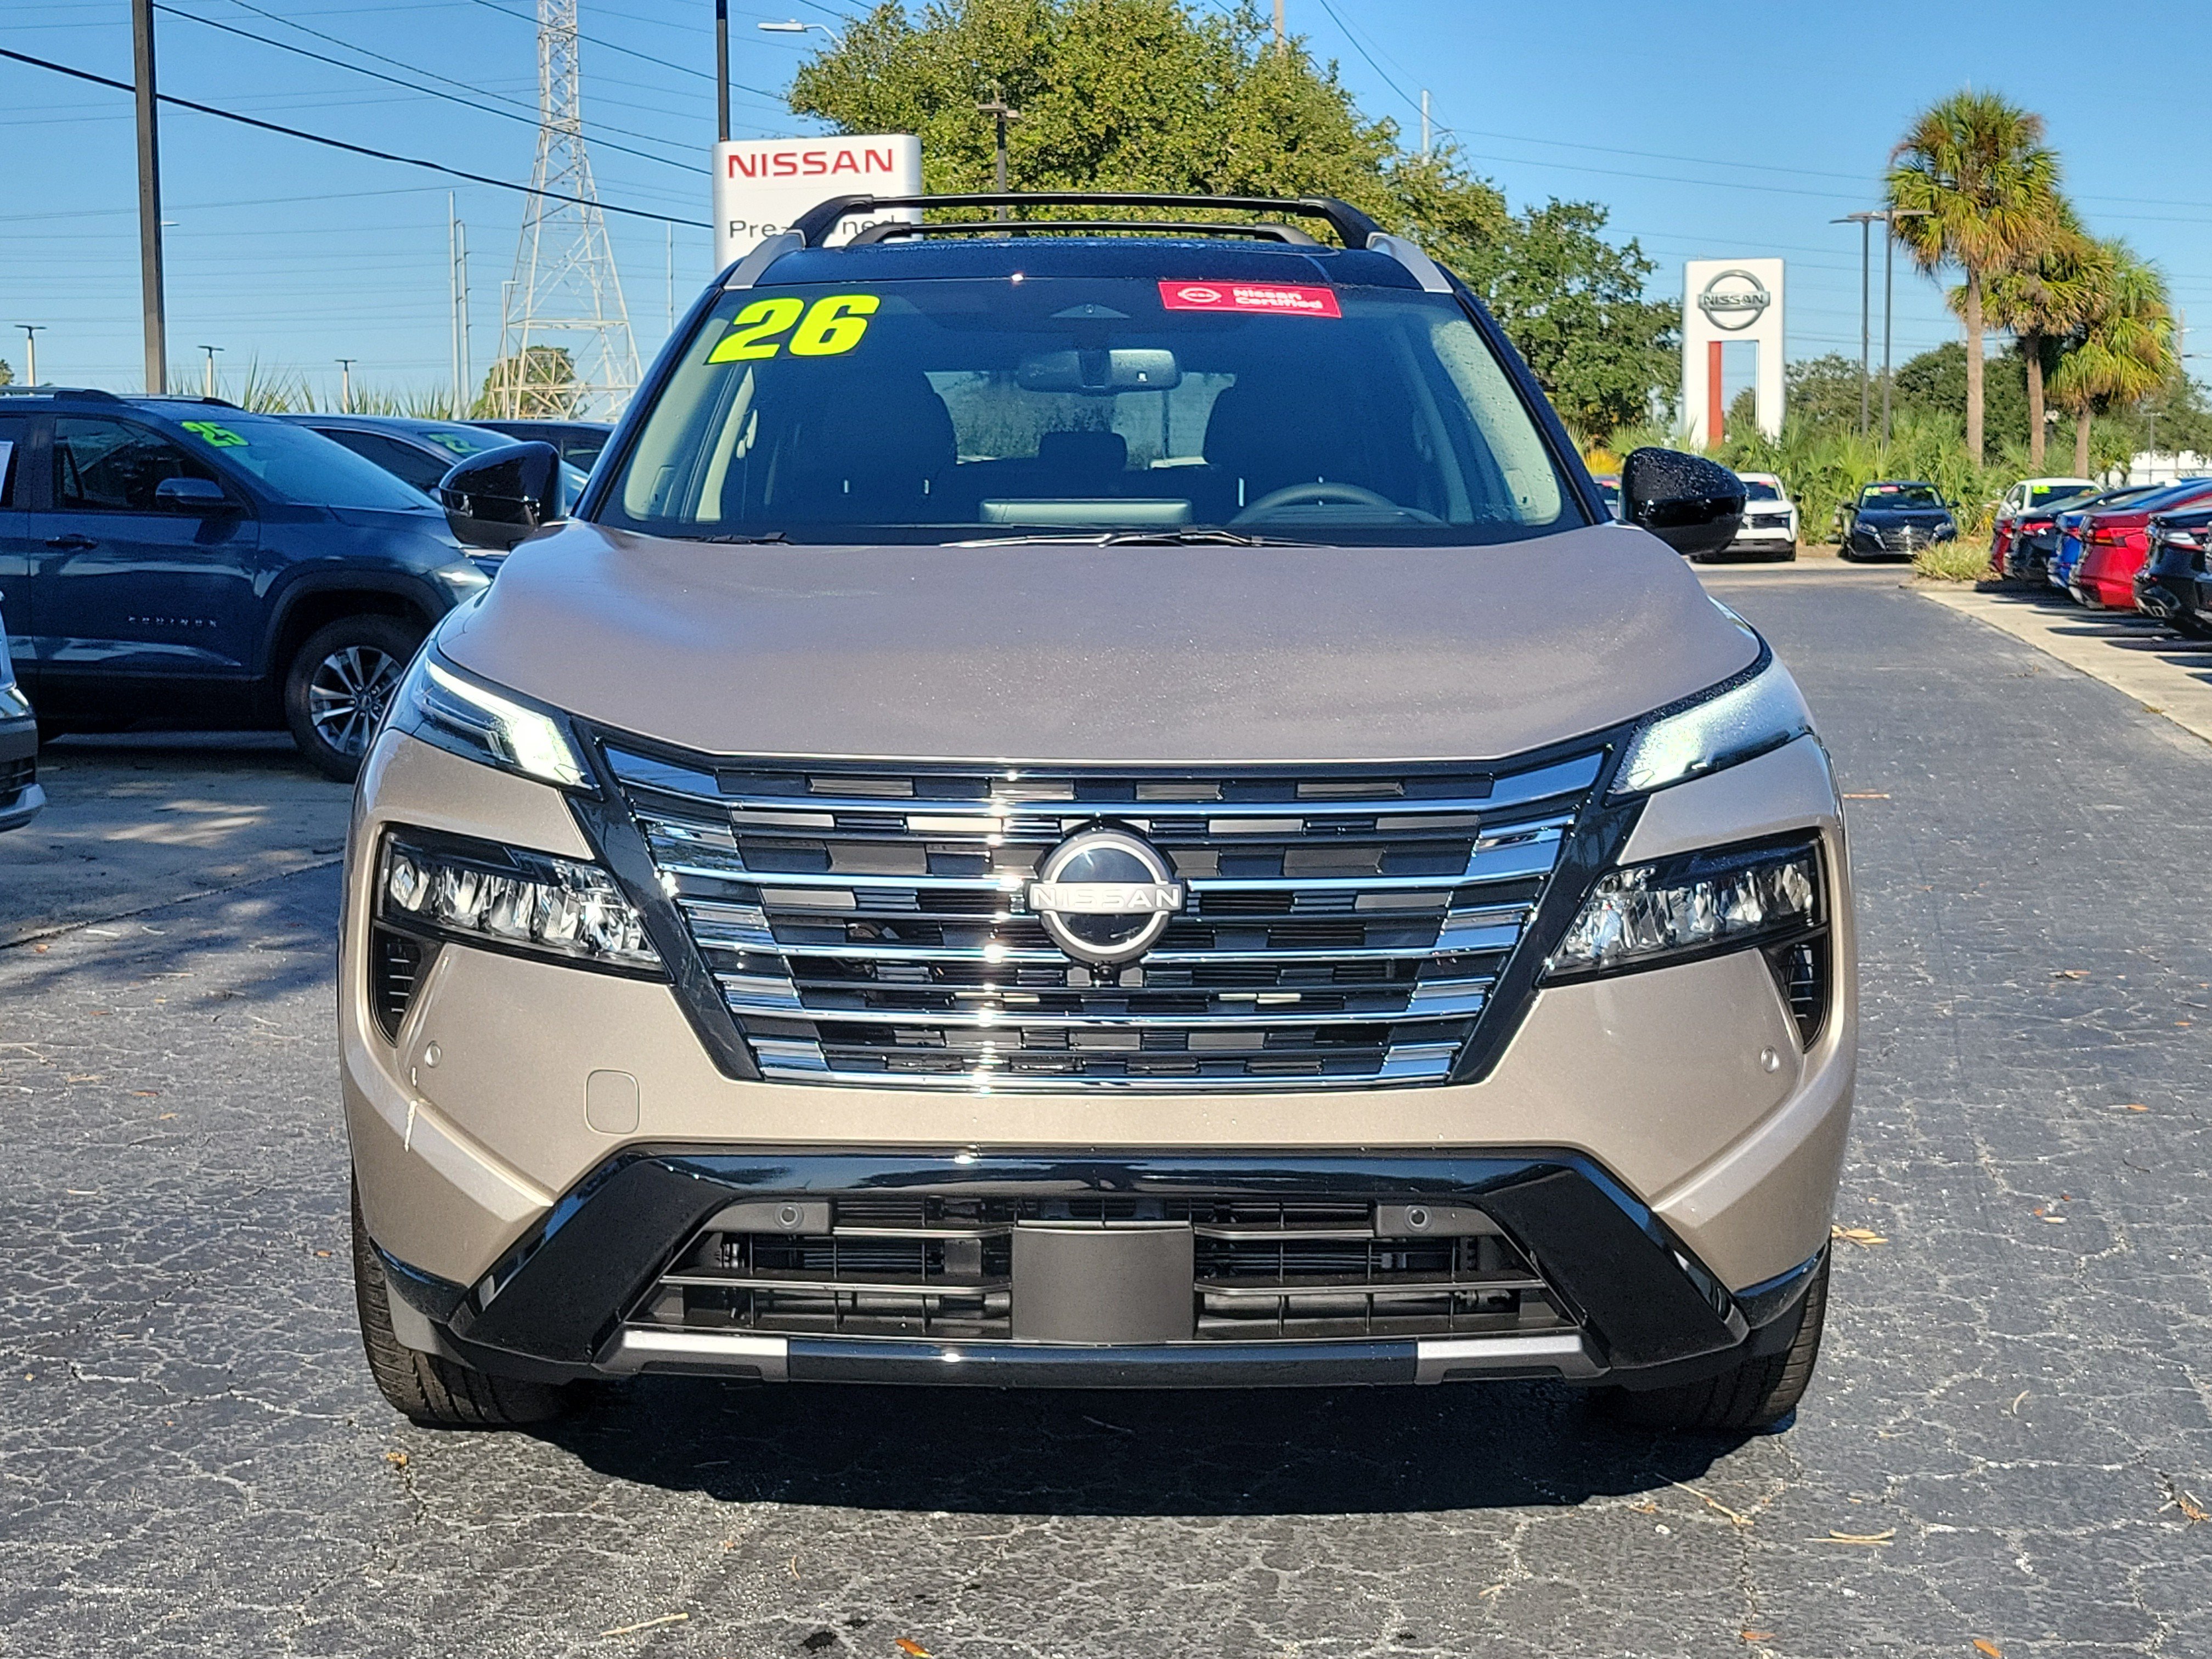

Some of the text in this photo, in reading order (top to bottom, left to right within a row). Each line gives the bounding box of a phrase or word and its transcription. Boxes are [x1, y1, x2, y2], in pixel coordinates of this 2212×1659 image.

[729, 149, 893, 178] NISSAN
[1233, 290, 1302, 301] Nissan
[1704, 294, 1763, 306] NISSAN
[708, 295, 880, 363] 26
[182, 421, 249, 447] 25
[1033, 888, 1178, 909] NISSAN
